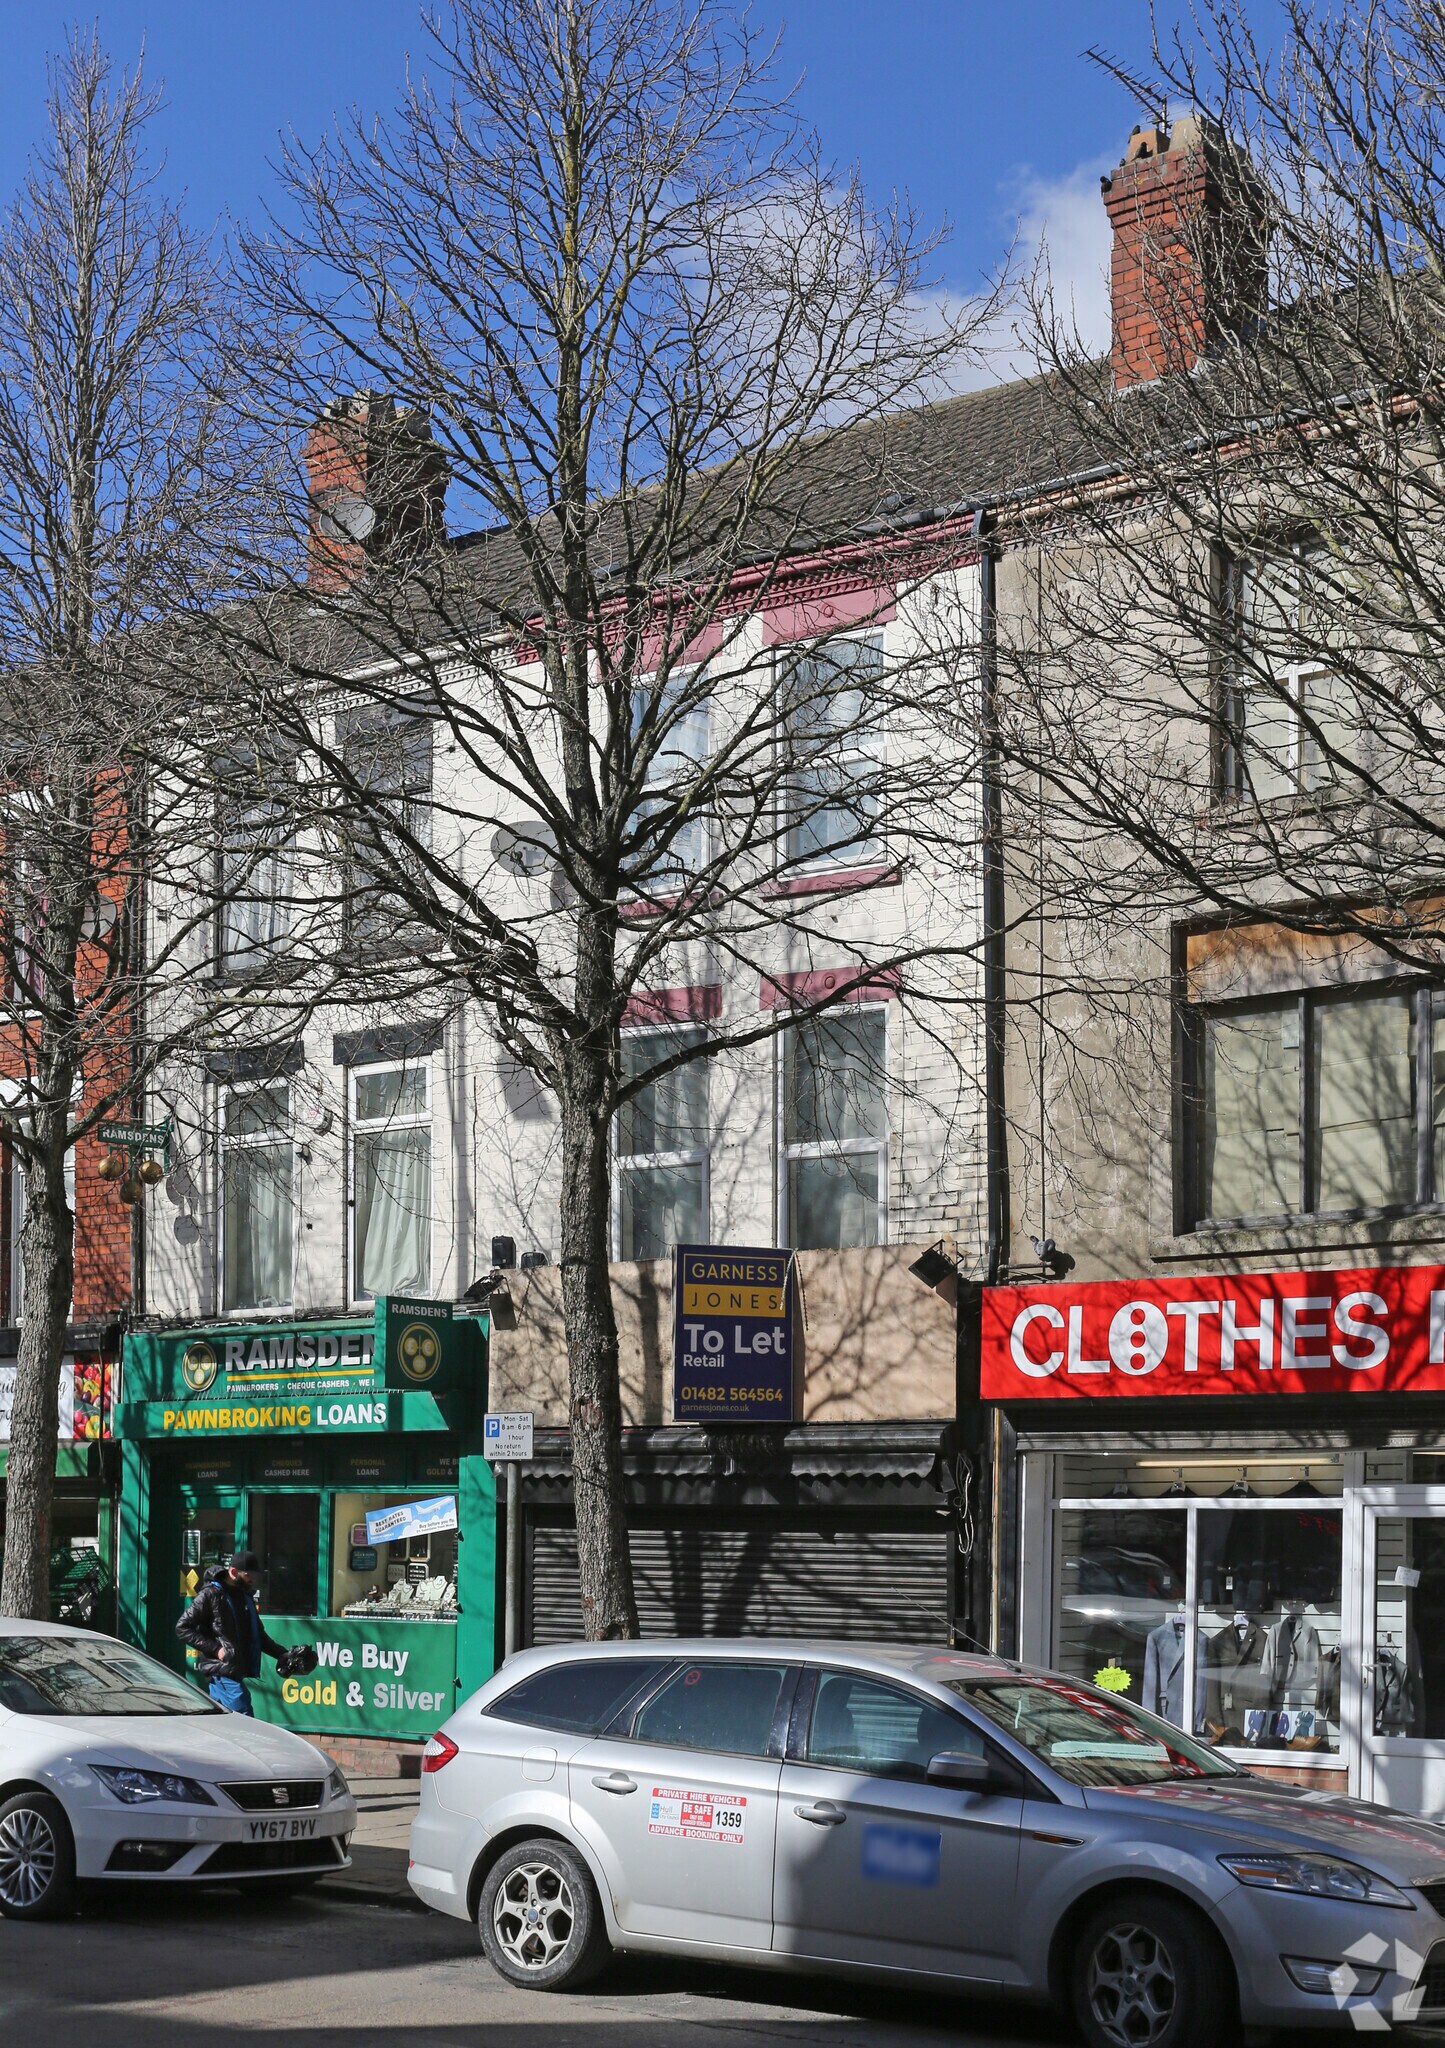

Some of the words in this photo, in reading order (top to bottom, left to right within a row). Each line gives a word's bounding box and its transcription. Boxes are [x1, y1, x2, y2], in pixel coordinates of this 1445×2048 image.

[102, 1128, 164, 1144] RAMSDENS
[691, 1263, 778, 1281] GARNESS
[691, 1292, 778, 1310] JONES
[391, 1303, 448, 1318] RAMSDENS
[683, 1323, 724, 1353] To
[734, 1325, 787, 1355] Let
[1009, 1290, 1390, 1378] CLOTHES
[683, 1354, 725, 1368] Retail
[226, 1383, 279, 1392] PAWNBROKERS
[287, 1381, 316, 1390] CHEQUE
[317, 1379, 350, 1388] CASHERS
[358, 1379, 370, 1387] WE
[681, 1387, 726, 1401] 01482
[729, 1388, 783, 1401] 564564
[680, 1403, 750, 1413] garnessjones.co.uk
[163, 1405, 311, 1430] PAWNBROKING
[316, 1403, 387, 1426] LOANS
[439, 1458, 451, 1466] WE
[197, 1470, 219, 1478] LOANS
[264, 1469, 291, 1477] CASHED
[426, 1468, 446, 1476] GOLD
[375, 1518, 387, 1528] BEST
[375, 1516, 406, 1533] GUARANTEED
[315, 1641, 353, 1667] We
[362, 1643, 409, 1676] Buy
[282, 1678, 337, 1705] Gold
[345, 1681, 365, 1707] &
[373, 1681, 446, 1712] Silver
[657, 1789, 689, 1800] PRIVATE
[689, 1792, 708, 1802] HIRE
[709, 1794, 741, 1805] VEHICLE
[683, 1803, 693, 1813] BE
[694, 1804, 712, 1815] SAFE
[715, 1811, 742, 1828] 1359
[250, 1820, 287, 1839] YY67
[290, 1819, 316, 1837] BYV
[650, 1825, 684, 1836] ADVANCE
[686, 1829, 720, 1840] BOOKING
[721, 1833, 743, 1843] ONLY
